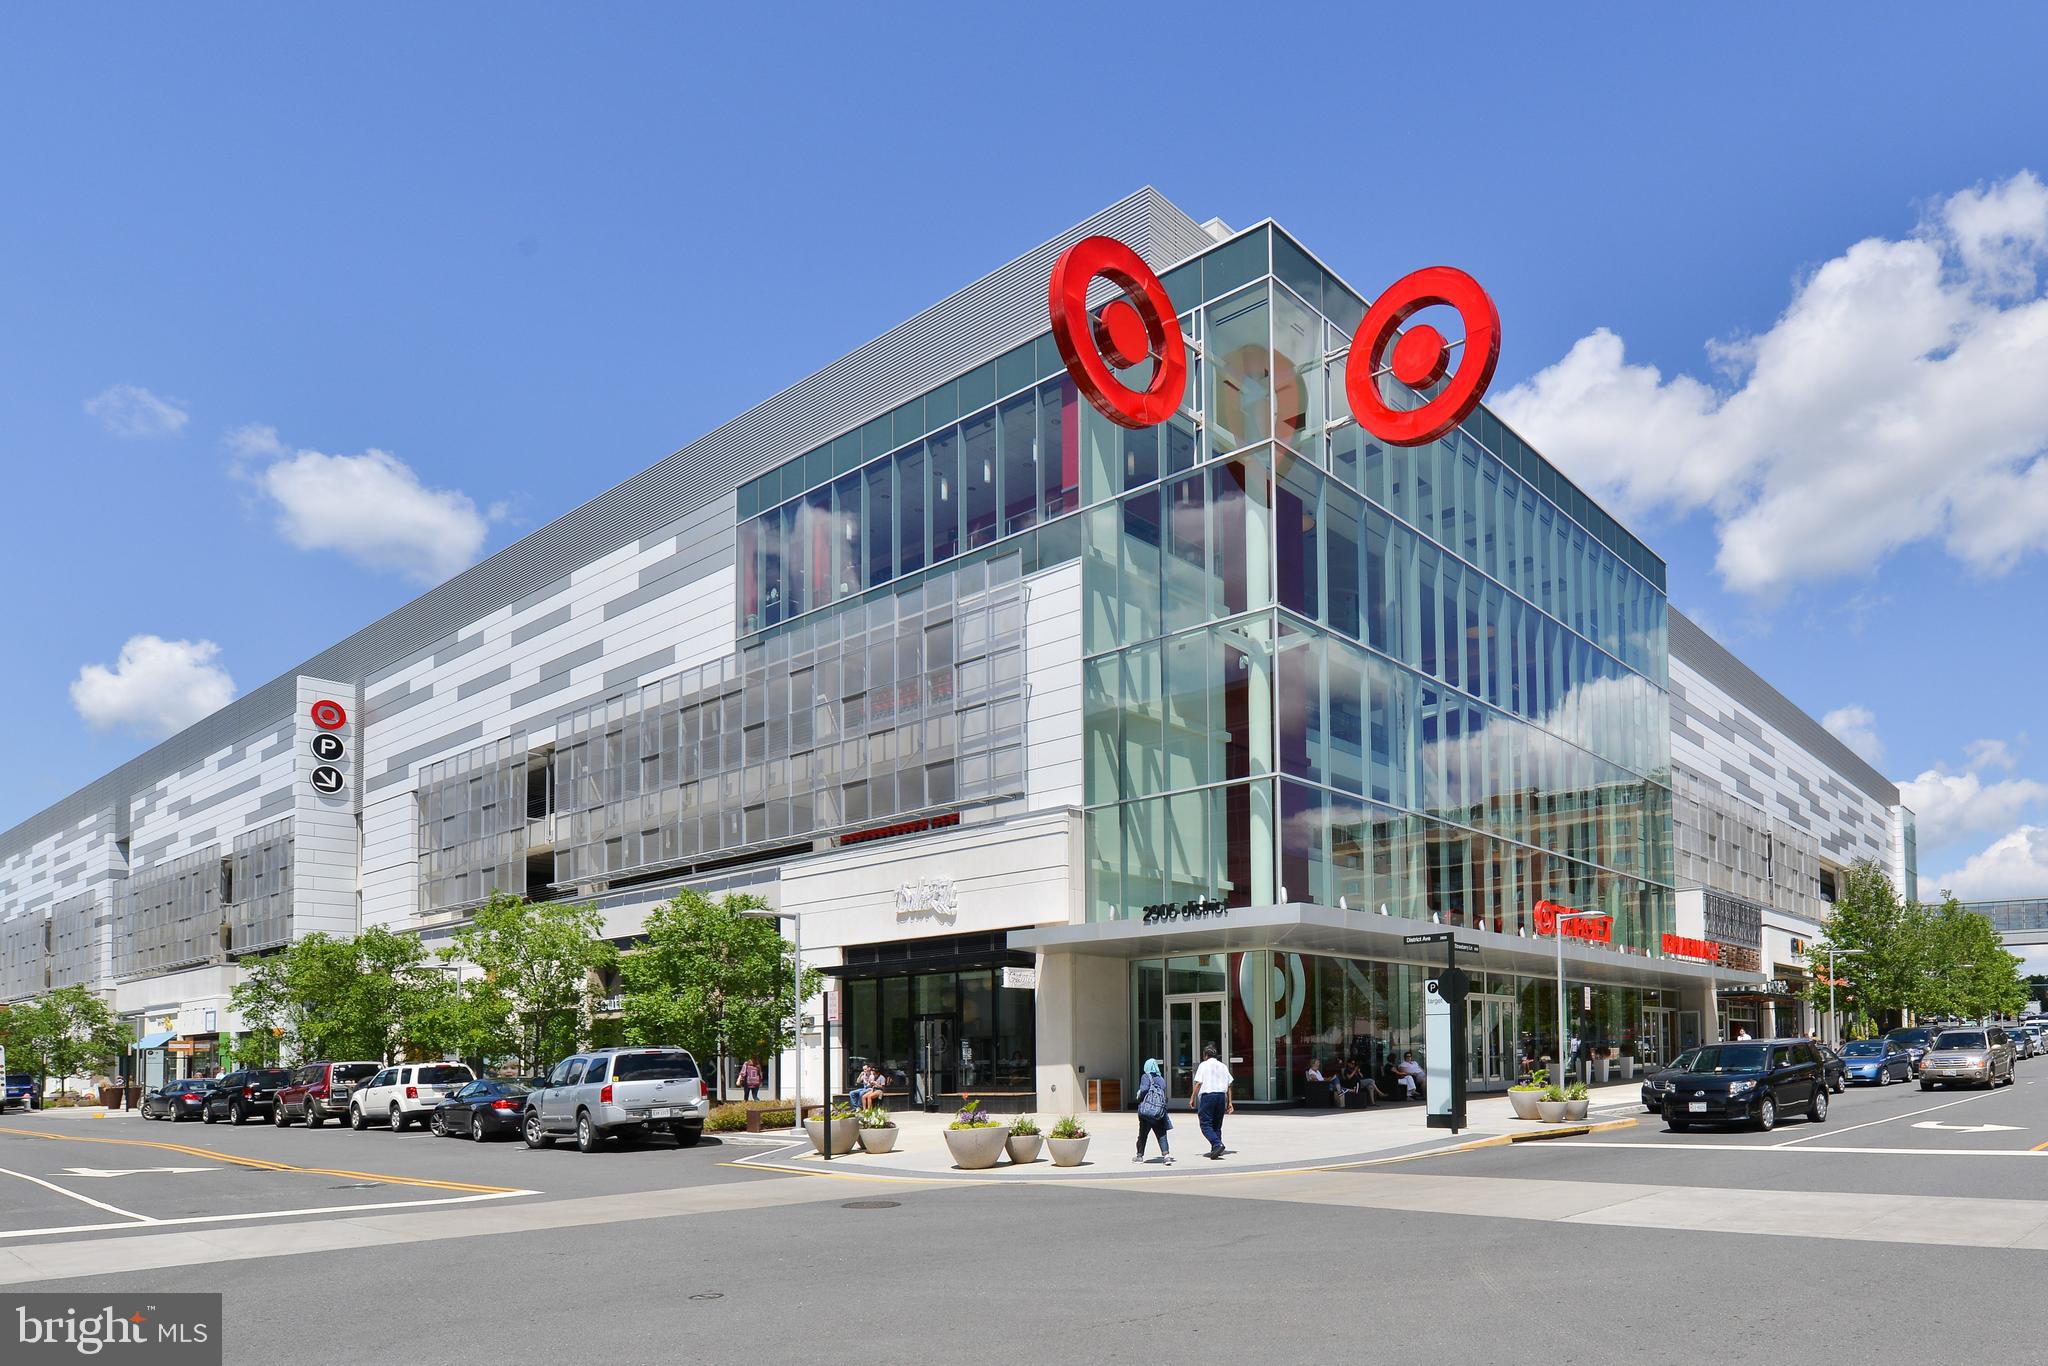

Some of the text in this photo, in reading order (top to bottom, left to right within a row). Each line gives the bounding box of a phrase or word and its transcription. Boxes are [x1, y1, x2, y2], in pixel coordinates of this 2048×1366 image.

[321, 738, 336, 754] P
[1181, 897, 1229, 918] district
[1430, 984, 1436, 992] P
